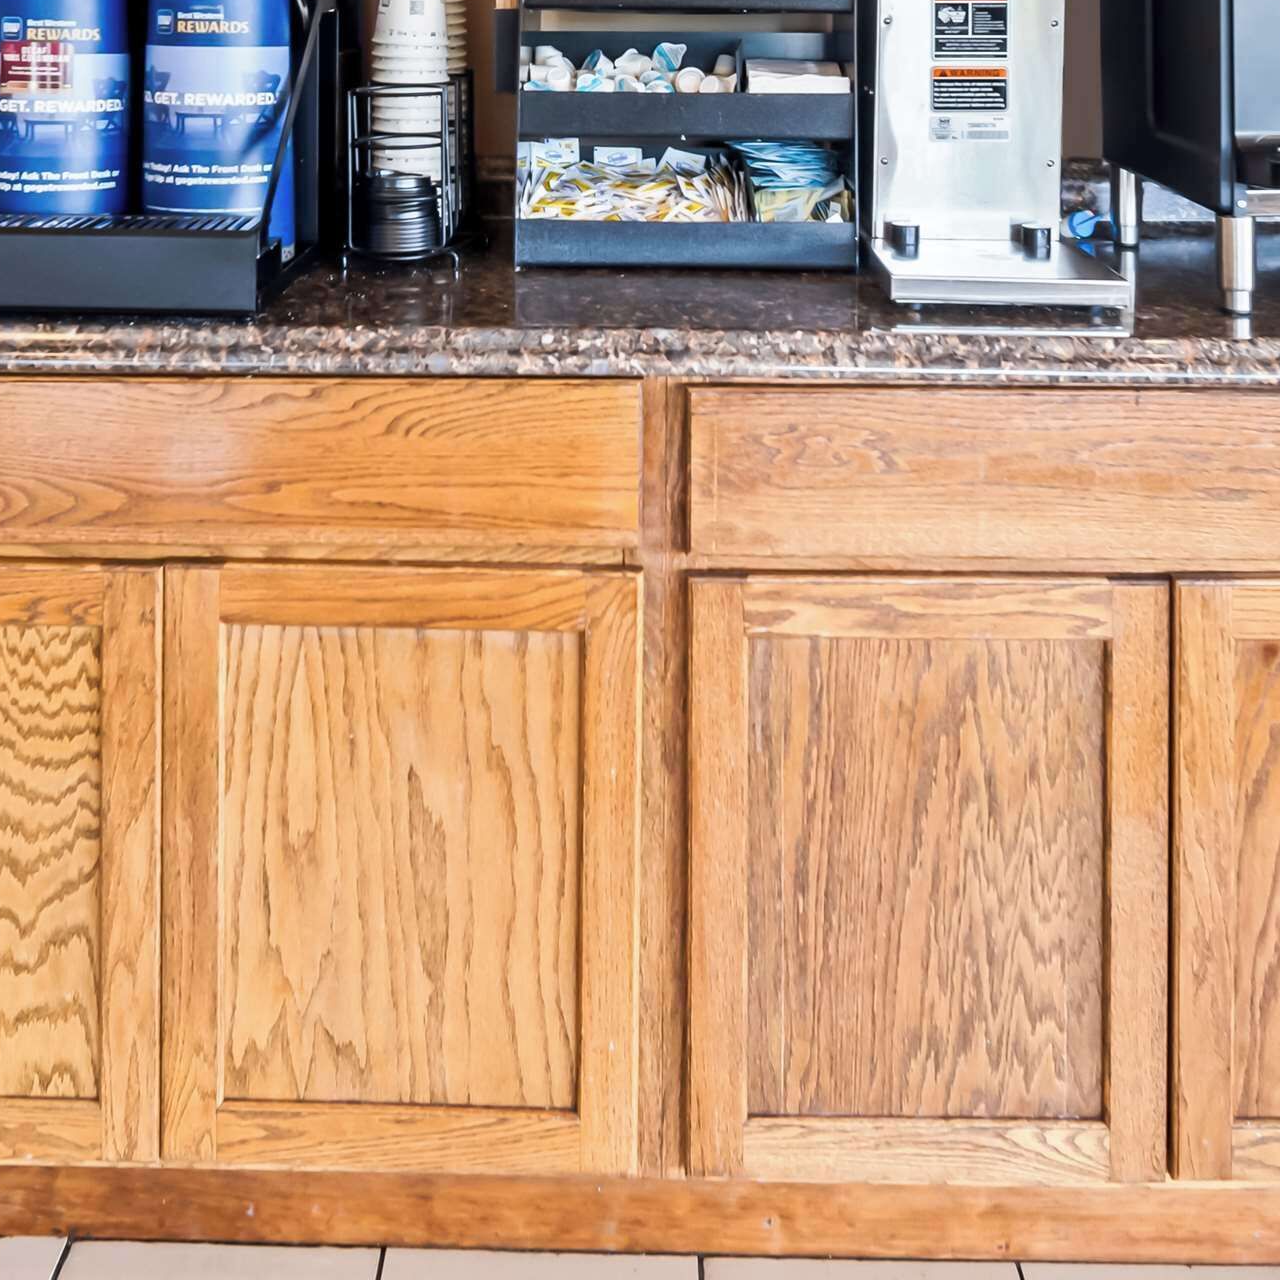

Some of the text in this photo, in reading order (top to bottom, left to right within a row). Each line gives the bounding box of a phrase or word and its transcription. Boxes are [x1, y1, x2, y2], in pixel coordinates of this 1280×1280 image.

[177, 21, 249, 34] REWARDS
[27, 28, 100, 41] REWARDS
[154, 92, 181, 105] GET.
[184, 92, 278, 106] REWARDED.
[0, 99, 30, 113] GET.
[33, 99, 124, 113] REWARDED.
[173, 164, 190, 173] Ask
[191, 165, 209, 173] The
[211, 165, 239, 173] Front
[240, 163, 262, 172] Desk
[21, 171, 39, 180] Ask
[41, 172, 61, 180] The
[62, 171, 90, 180] Front
[90, 170, 111, 179] Desk
[175, 175, 268, 186] gogetrewarded.com
[23, 181, 116, 193] gogetrewarded.com
